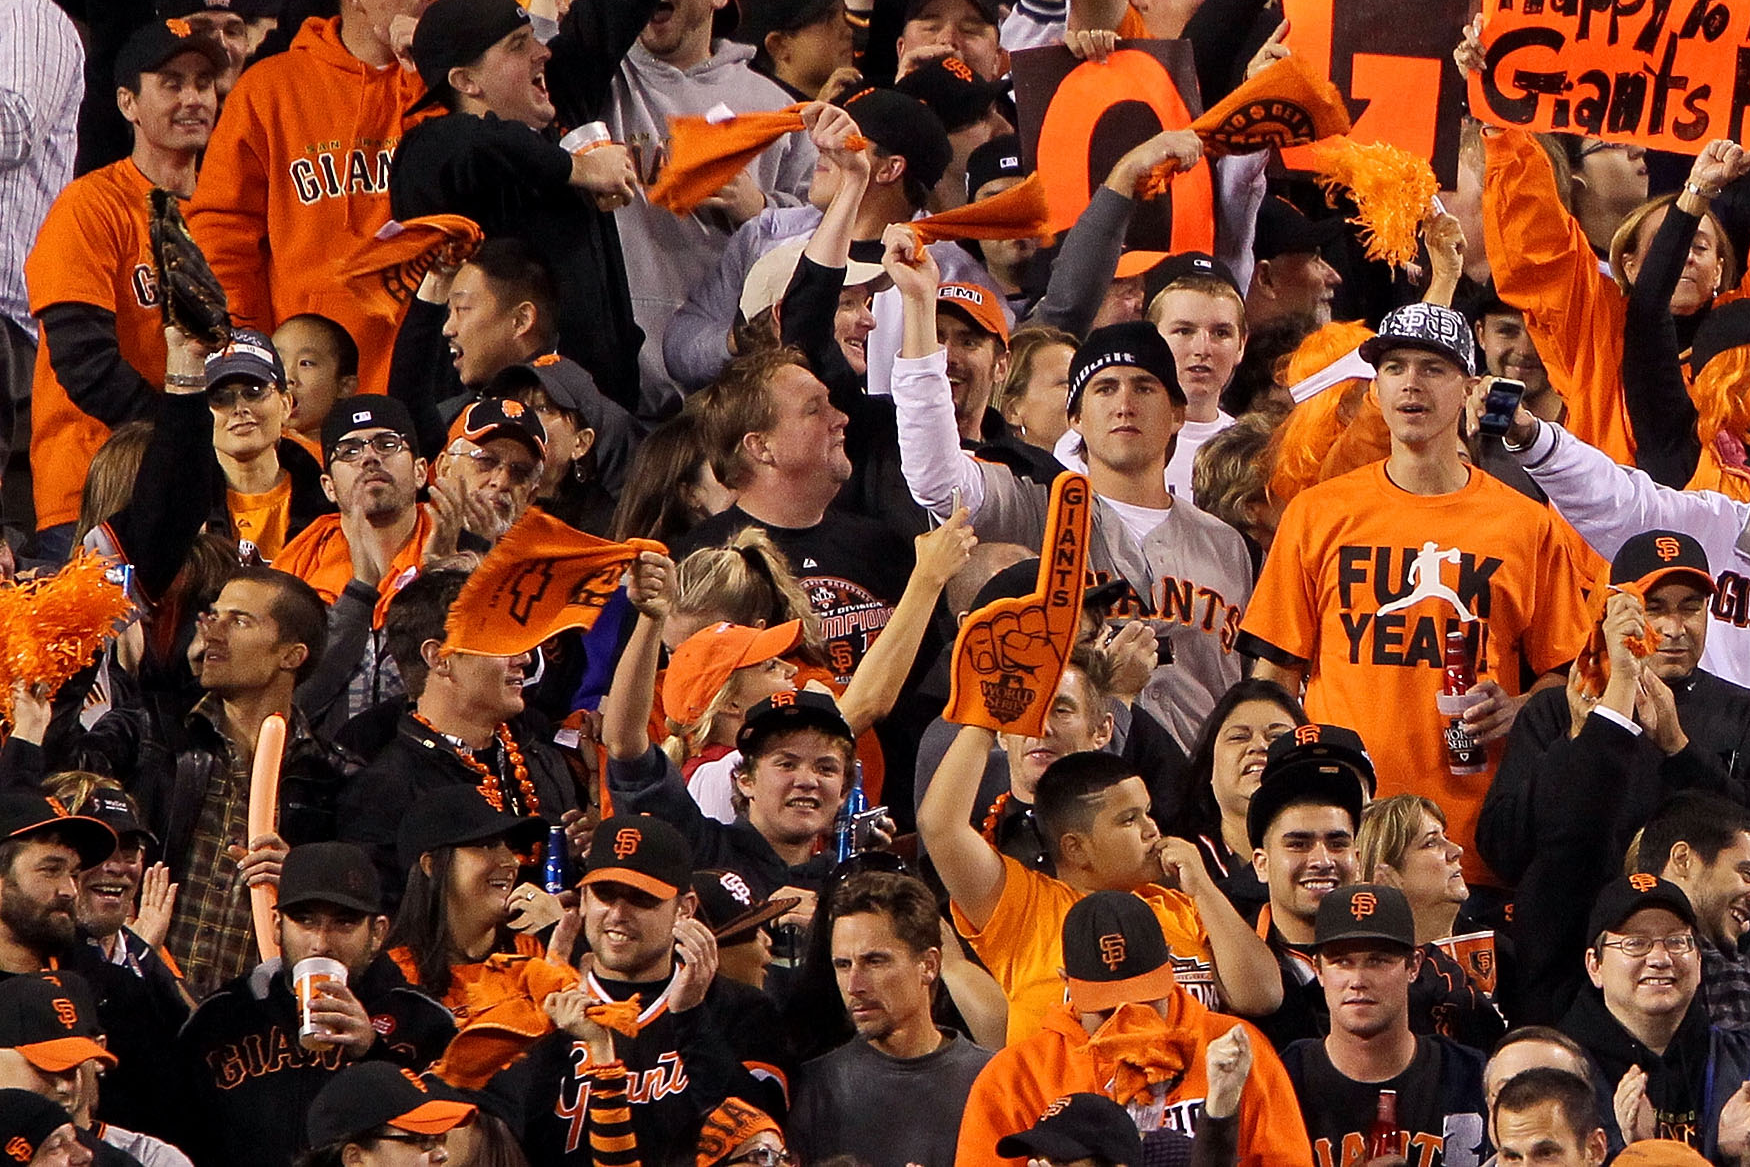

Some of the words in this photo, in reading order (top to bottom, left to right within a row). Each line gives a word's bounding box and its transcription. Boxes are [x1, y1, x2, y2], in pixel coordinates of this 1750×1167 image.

[1480, 25, 1712, 142] Giants
[1656, 537, 1681, 563] SF
[836, 601, 884, 615] DIVISION
[615, 829, 642, 860] SF
[721, 873, 752, 906] SF
[1630, 873, 1658, 894] SF
[1352, 892, 1378, 921] SF
[1101, 934, 1126, 972] SF
[53, 999, 77, 1031] SF
